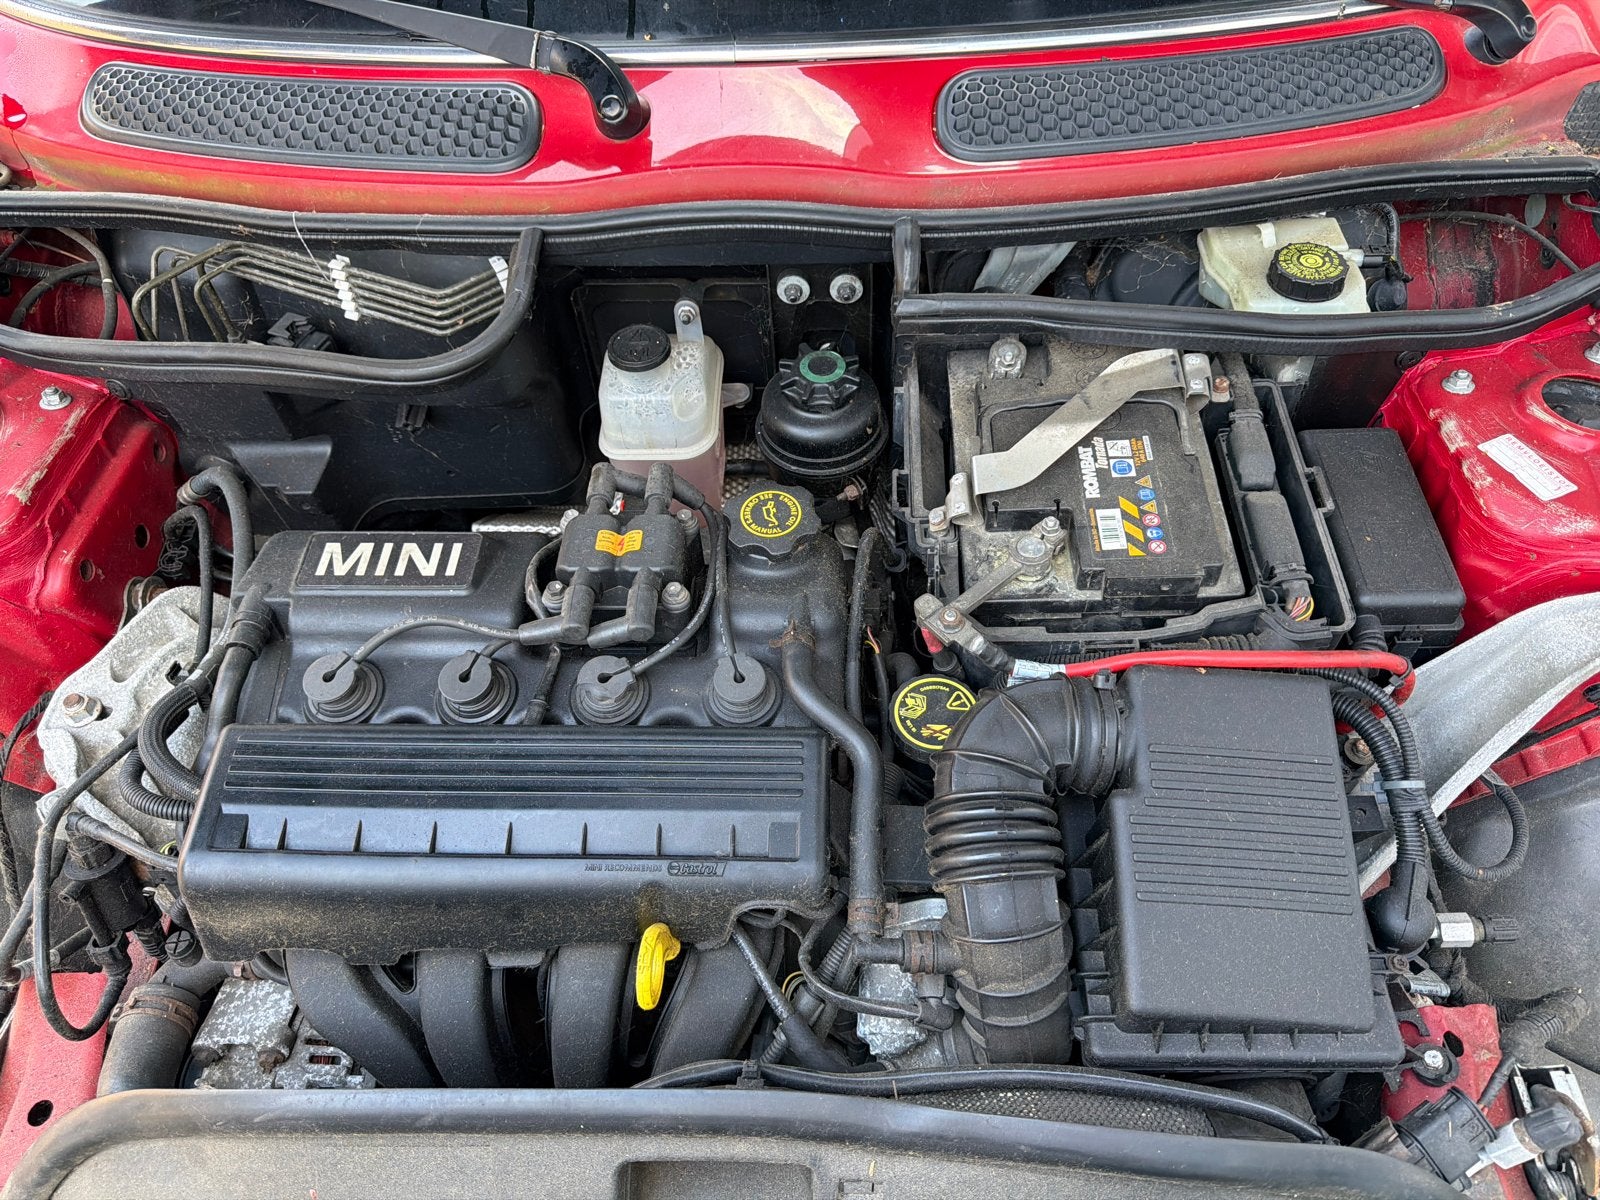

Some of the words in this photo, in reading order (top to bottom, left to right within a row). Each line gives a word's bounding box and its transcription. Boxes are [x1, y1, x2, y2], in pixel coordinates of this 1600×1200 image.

[1091, 436, 1108, 469] Tornada
[1077, 446, 1100, 498] ROMBAT
[779, 495, 797, 515] ENGINE
[750, 523, 782, 534] MANUAL
[785, 516, 796, 527] OIL
[314, 542, 463, 577] MINI
[584, 863, 603, 872] MINI
[604, 863, 663, 873] RECOMMENDS
[680, 862, 718, 875] Castrol
